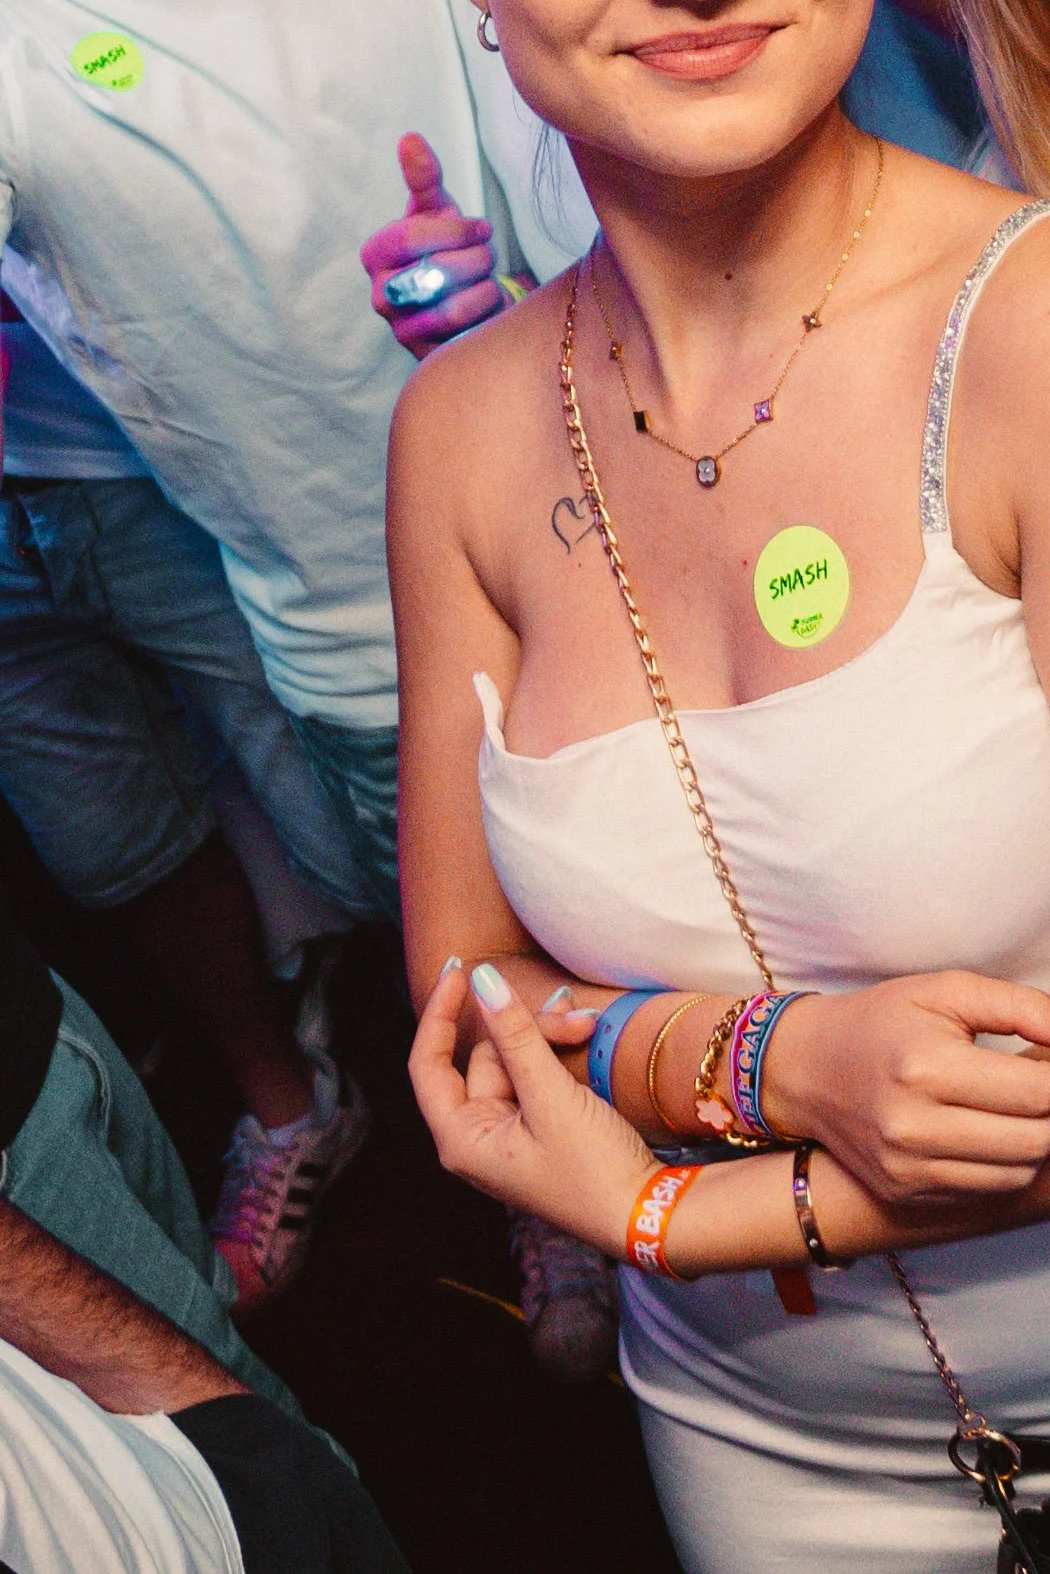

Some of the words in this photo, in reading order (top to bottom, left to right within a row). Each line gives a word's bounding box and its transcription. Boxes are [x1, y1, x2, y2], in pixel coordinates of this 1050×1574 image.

[83, 44, 126, 75] SMASH
[768, 558, 827, 600] SMASH
[636, 1175, 686, 1237] BASH
